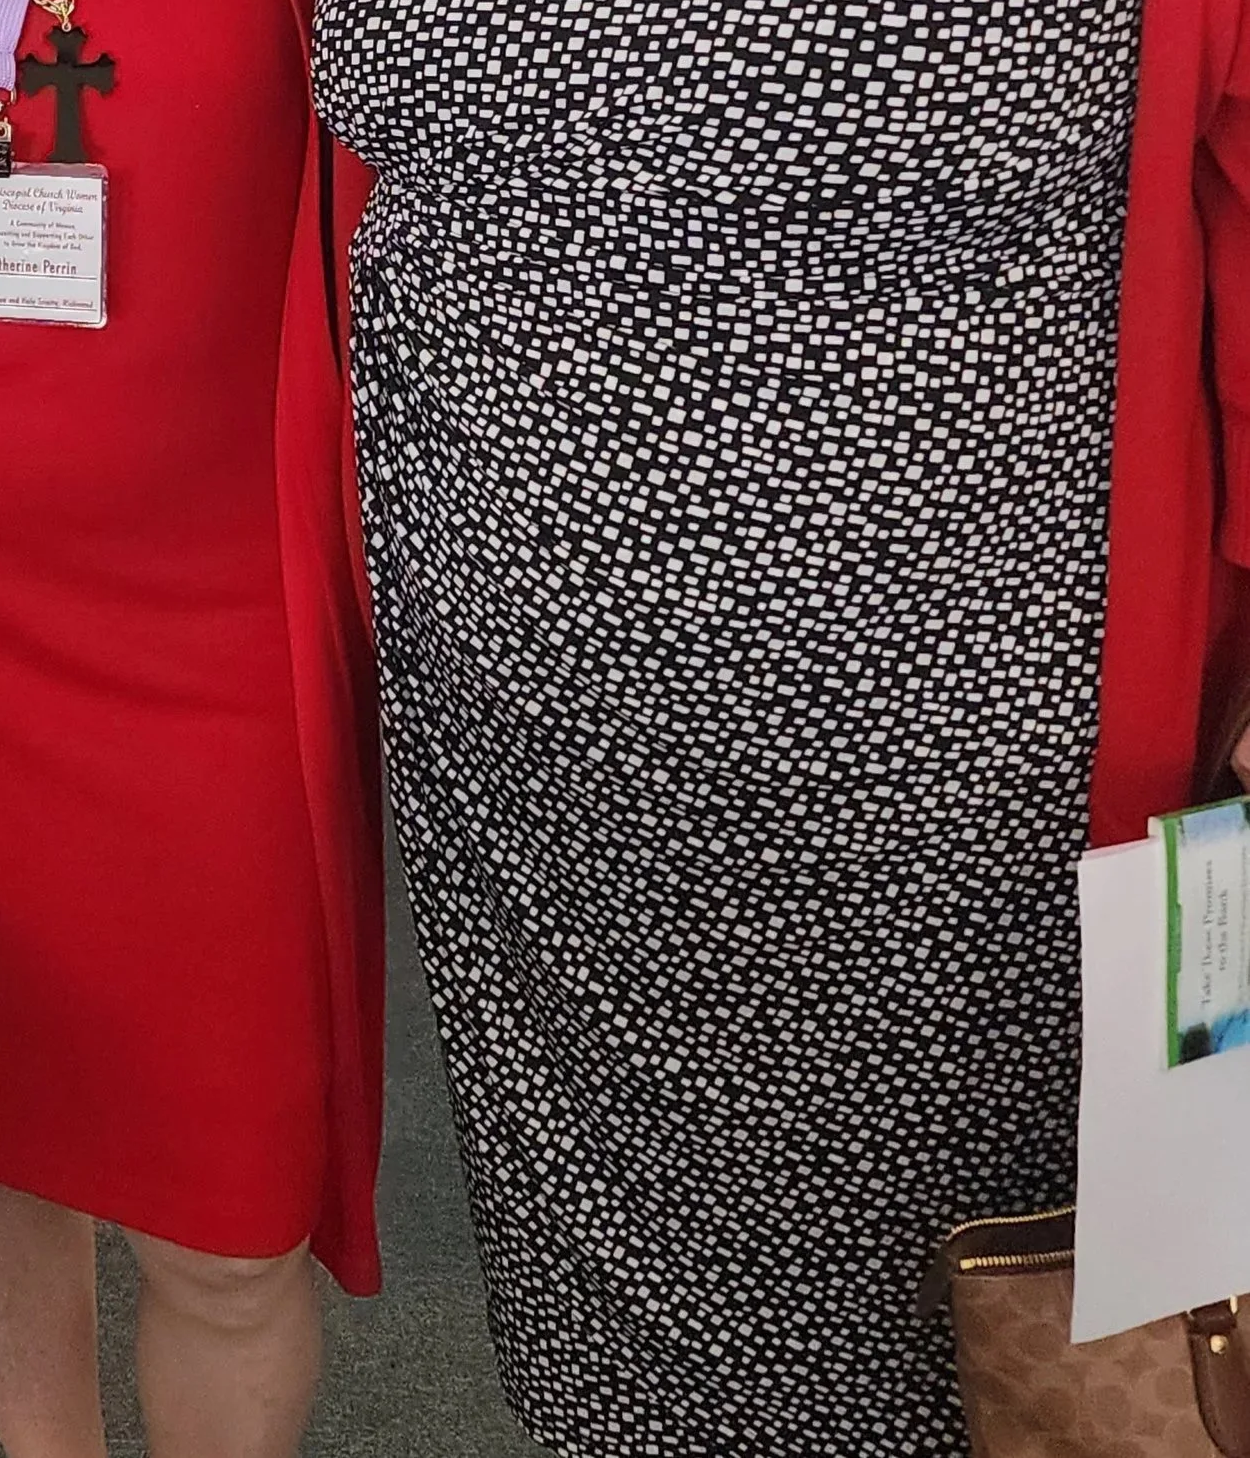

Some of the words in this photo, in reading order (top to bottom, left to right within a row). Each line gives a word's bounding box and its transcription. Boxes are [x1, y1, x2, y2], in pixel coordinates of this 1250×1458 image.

[33, 186, 64, 200] Church
[66, 188, 98, 201] Women
[2, 198, 35, 211] Diocese
[36, 200, 47, 214] of
[43, 259, 77, 275] Perrin
